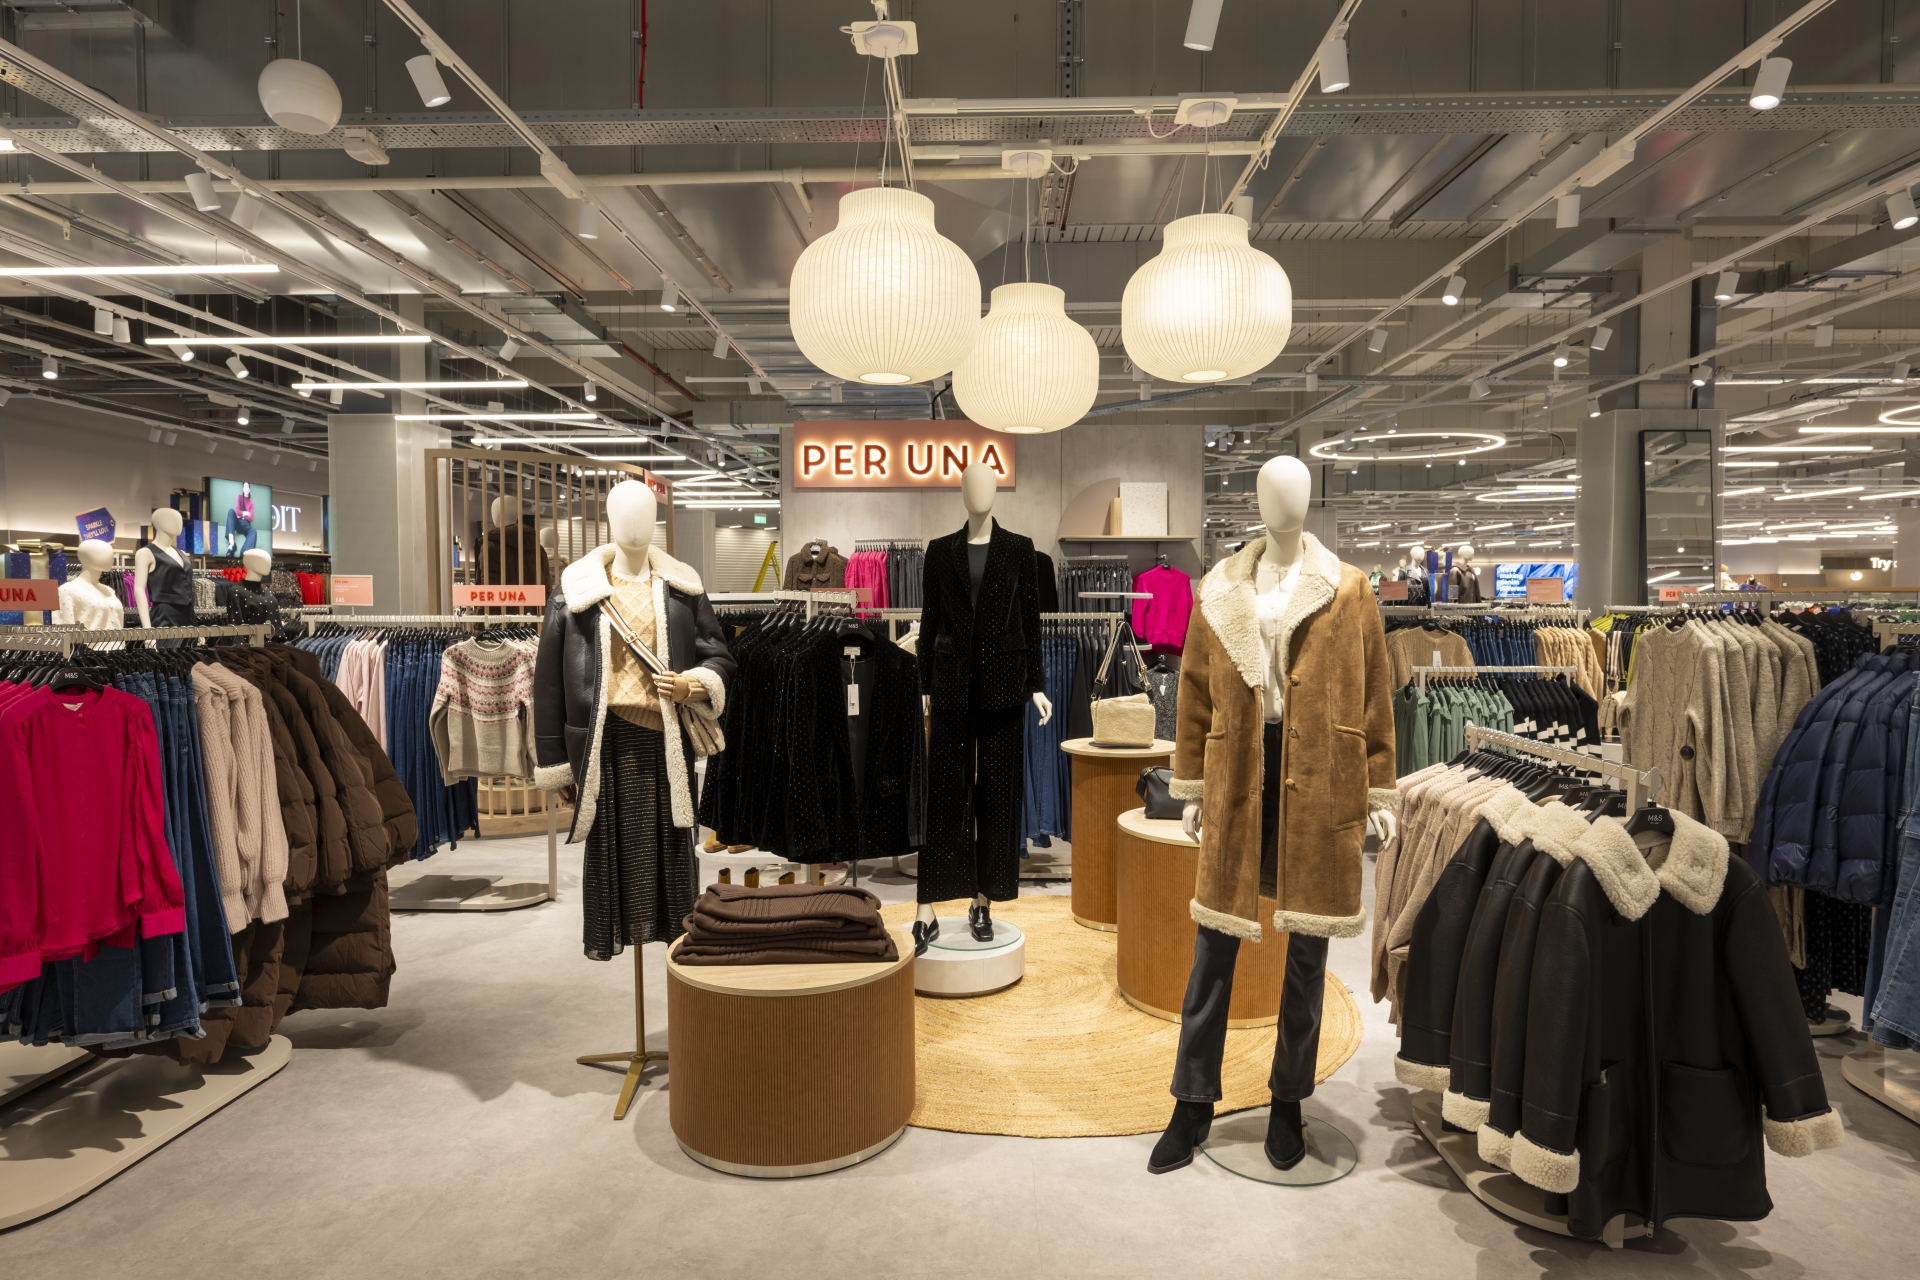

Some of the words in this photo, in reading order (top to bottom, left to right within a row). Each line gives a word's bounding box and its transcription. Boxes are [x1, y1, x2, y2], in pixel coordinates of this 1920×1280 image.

[803, 444, 887, 475] PER
[907, 444, 1005, 475] UNA
[85, 520, 103, 531] SPARKLE
[1870, 557, 1893, 572] Try
[0, 588, 37, 602] UNA
[470, 591, 495, 601] PER
[498, 591, 527, 602] UNA
